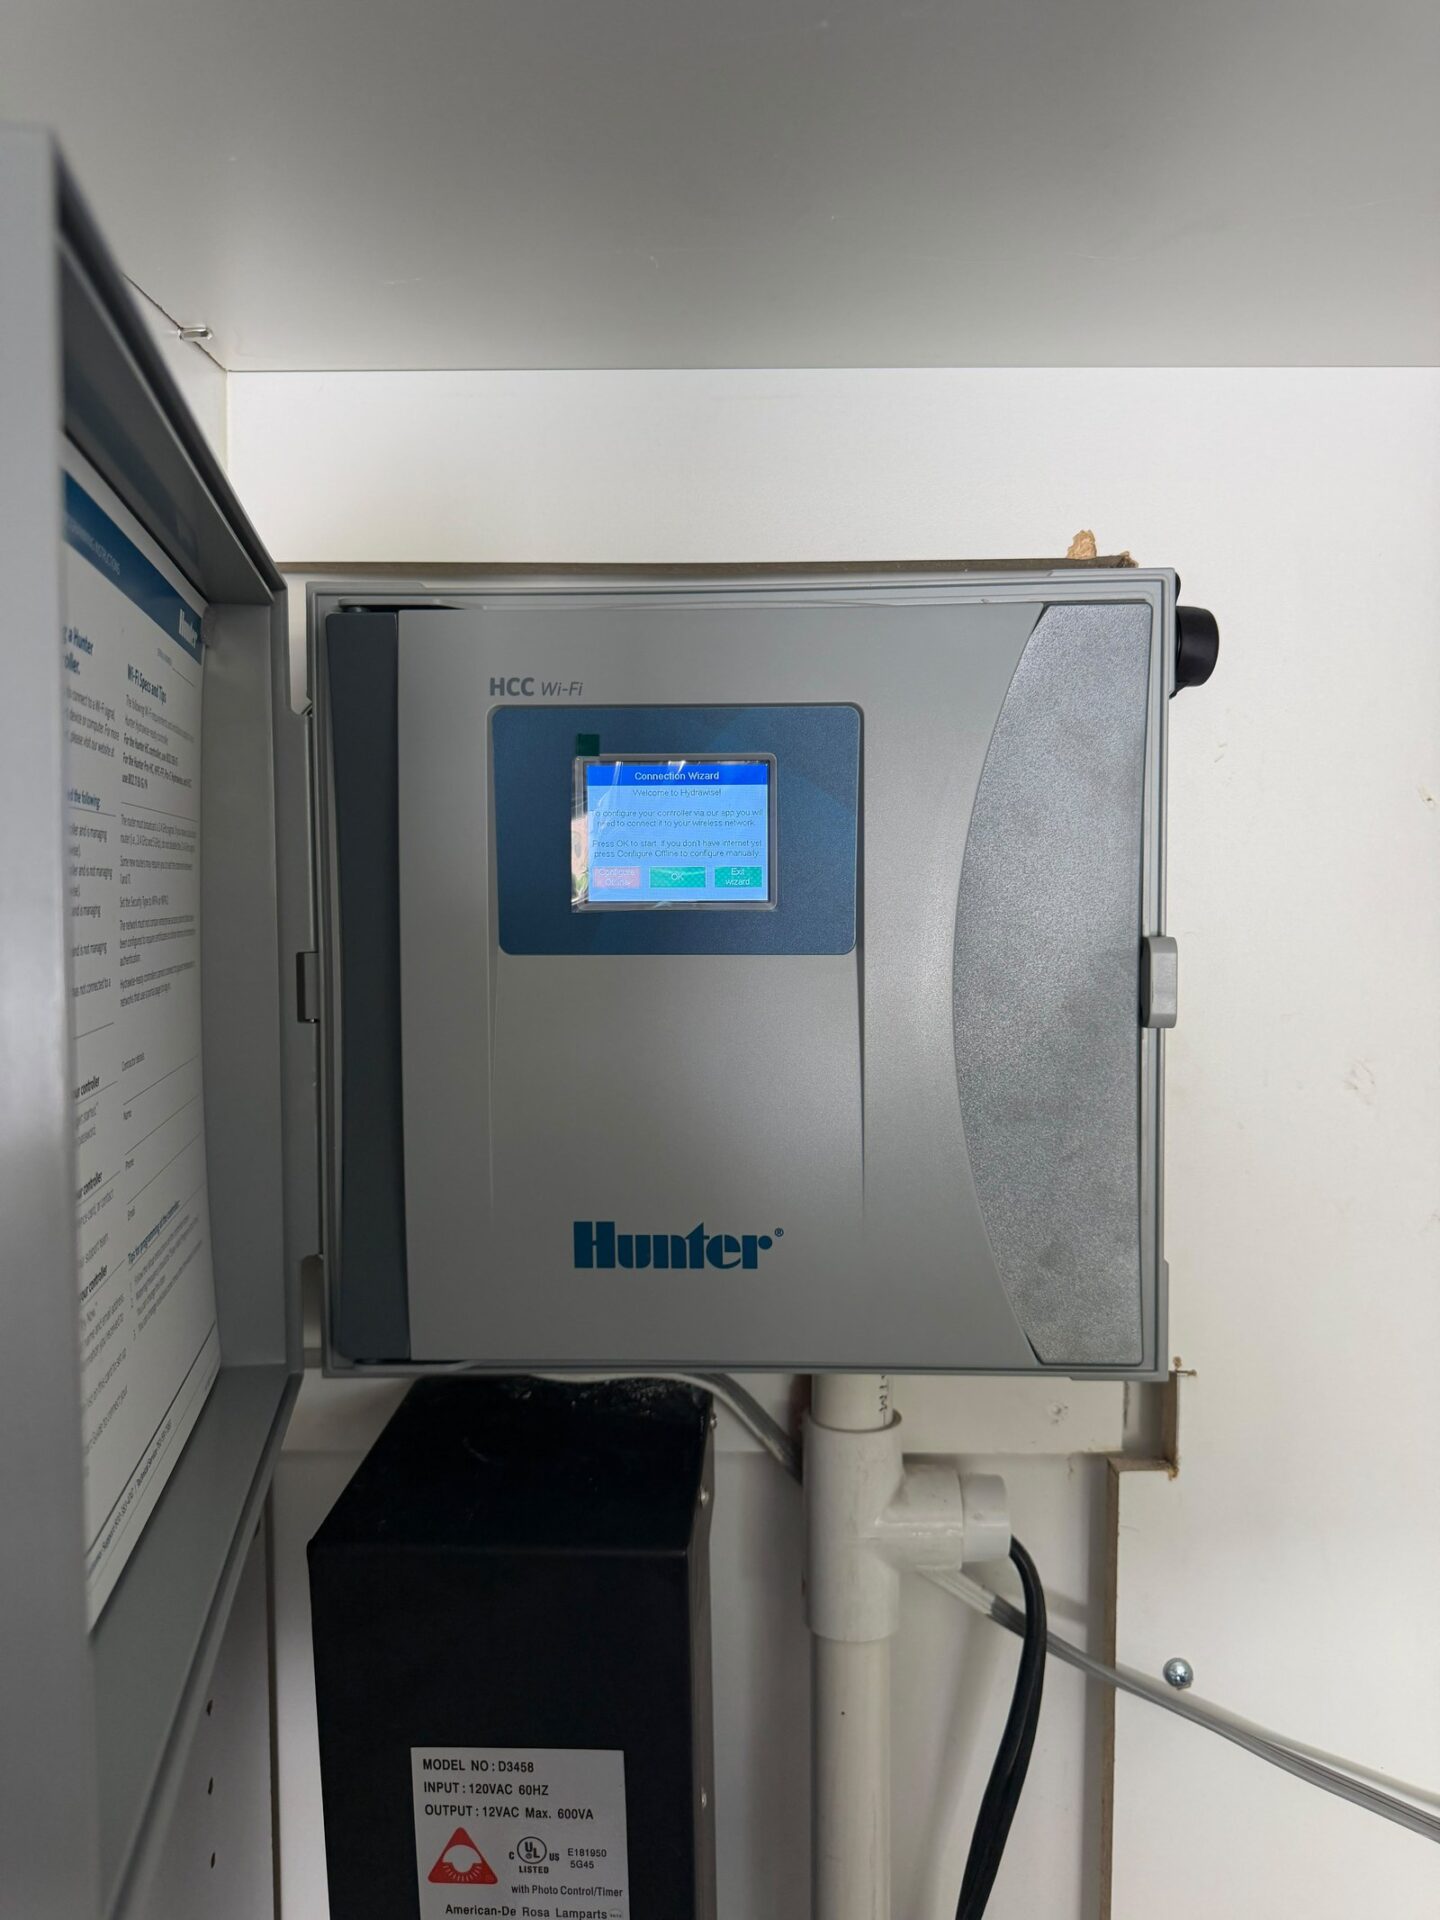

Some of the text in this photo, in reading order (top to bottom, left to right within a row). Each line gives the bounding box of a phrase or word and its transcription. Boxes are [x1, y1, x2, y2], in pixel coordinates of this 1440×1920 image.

[74, 627, 94, 656] Hunter
[488, 676, 584, 697] HCC Wi-Fi
[634, 771, 720, 781] Connection Wizard
[632, 788, 722, 798] Welcome to Hydrawise!
[602, 809, 637, 819] configure
[638, 810, 655, 819] your
[657, 809, 693, 817] controller
[694, 809, 705, 817] via
[721, 810, 735, 819] app
[736, 810, 751, 819] you
[616, 819, 625, 827] to
[626, 819, 657, 827] connect
[658, 819, 664, 827] it
[664, 819, 673, 827] to
[673, 820, 691, 829] your
[692, 819, 723, 827] wireless
[592, 839, 615, 847] Press
[616, 839, 629, 847] OK
[630, 839, 639, 847] to
[666, 841, 681, 849] you
[682, 839, 701, 847] don't
[702, 839, 720, 847] have
[721, 839, 749, 847] internet
[593, 850, 615, 859] press
[616, 849, 653, 859] Configure
[654, 849, 679, 857] Offline
[680, 849, 689, 857] to
[689, 849, 725, 859] configure
[730, 867, 746, 876] Exit
[670, 872, 685, 882] OK
[725, 877, 750, 886] wizard
[80, 1075, 100, 1096] controller
[83, 1171, 103, 1196] controller
[88, 1264, 108, 1293] controller
[422, 1759, 465, 1771] MODEL
[498, 1761, 535, 1773] D3458
[469, 1783, 513, 1795] 120VAC
[518, 1784, 549, 1796] 60HZ
[482, 1806, 520, 1818] 12VAC
[525, 1808, 552, 1819] Max.
[557, 1808, 594, 1820] 600VA
[567, 1848, 607, 1858] E181950
[518, 1865, 549, 1874] LISTED
[570, 1860, 594, 1869] 5G45
[511, 1885, 623, 1898] with Photo Control/Timer
[445, 1904, 517, 1917] American-De
[522, 1906, 550, 1918] Rosa
[555, 1907, 608, 1920] Lamparts
